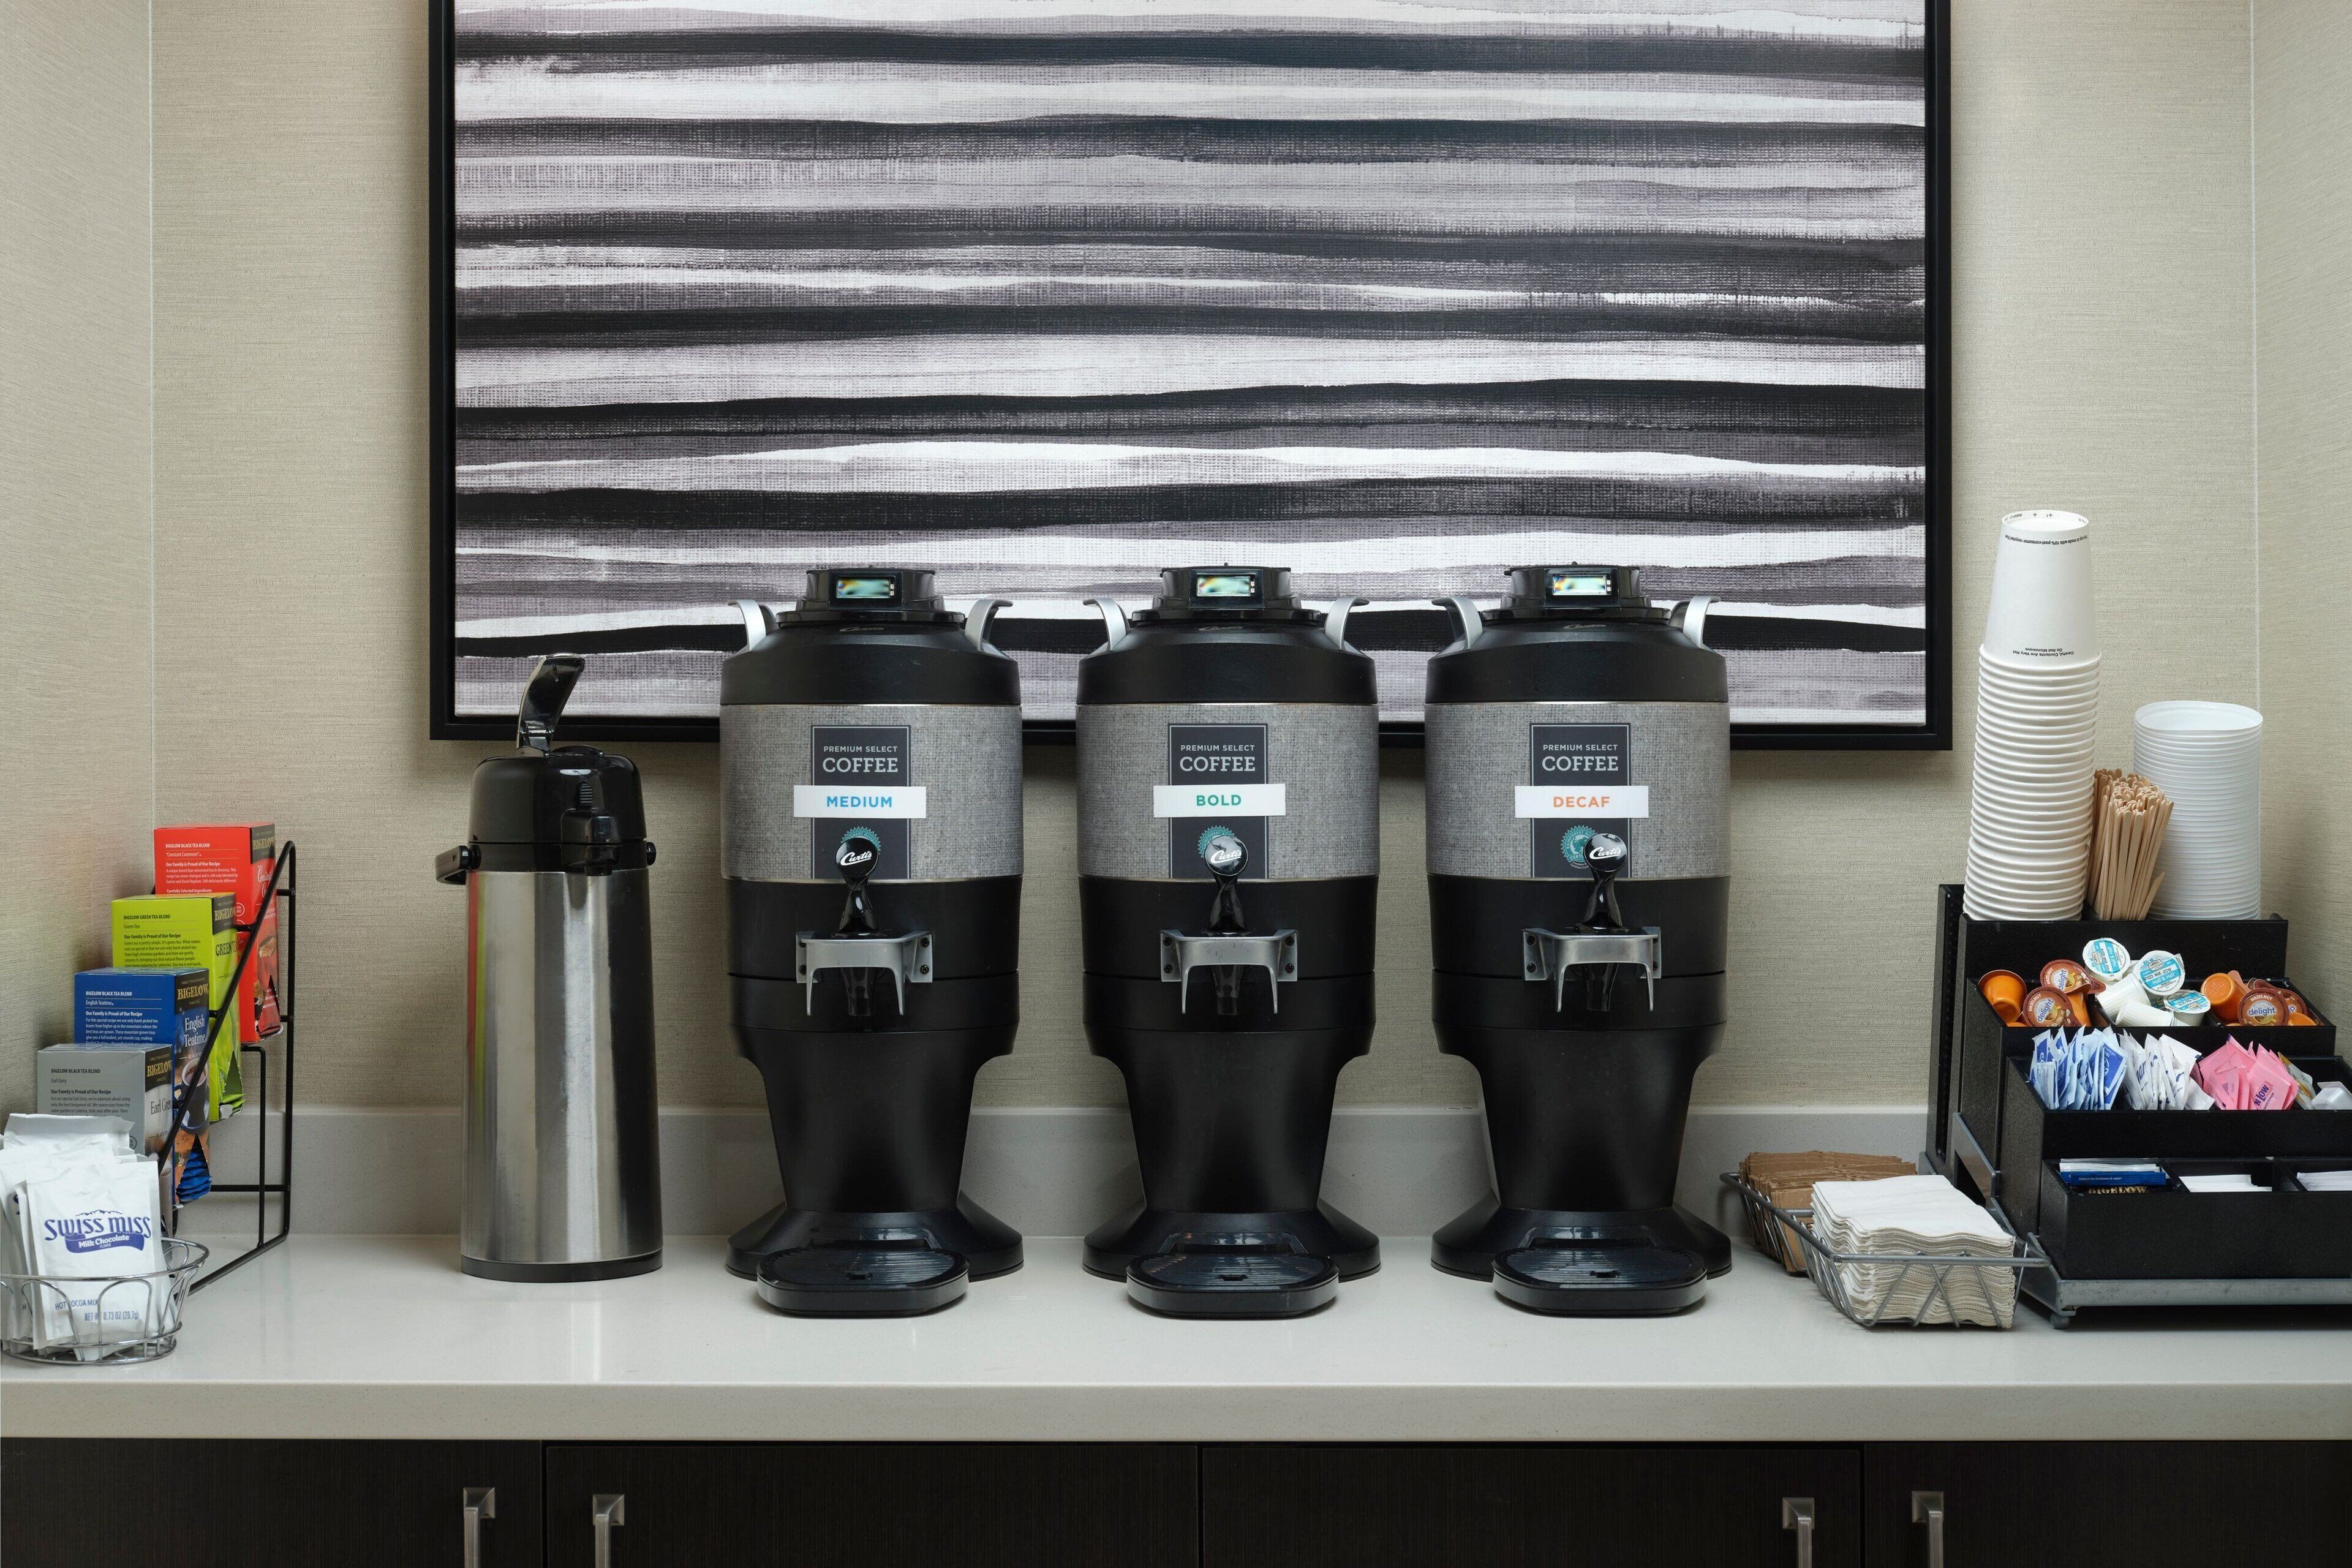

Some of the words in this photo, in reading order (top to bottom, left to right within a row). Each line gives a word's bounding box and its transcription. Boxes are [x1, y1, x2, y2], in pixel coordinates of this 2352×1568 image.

[823, 757, 898, 773] COFFEE
[1180, 756, 1255, 771] COFFEE
[1542, 756, 1619, 771] COFFEE
[827, 796, 892, 807] MEDIUM
[1196, 794, 1241, 806] BOLD
[1553, 796, 1610, 807] DECAF
[840, 850, 872, 866] Curtis
[1210, 849, 1241, 864] Curtis
[1589, 846, 1621, 860] Curtis
[215, 942, 232, 956] GREEN
[2045, 967, 2054, 985] HAZELNUT
[2058, 969, 2067, 990] delight
[177, 983, 209, 1000] BIGELOW
[2028, 993, 2042, 1012] HAZELNUT
[2037, 998, 2054, 1022] delight
[2248, 1007, 2276, 1016] delight
[185, 1014, 205, 1033] English
[184, 1033, 205, 1047] Teatime
[147, 1060, 172, 1077] BIGELOW
[2256, 1084, 2269, 1102] LOW
[151, 1101, 160, 1114] Earl
[95, 1234, 130, 1245] Chocolate
[55, 1301, 66, 1310] HOT
[85, 1313, 93, 1321] NET
[104, 1312, 114, 1320] 0.73
[115, 1311, 122, 1320] OZ
[123, 1311, 139, 1320] (20.7g)
